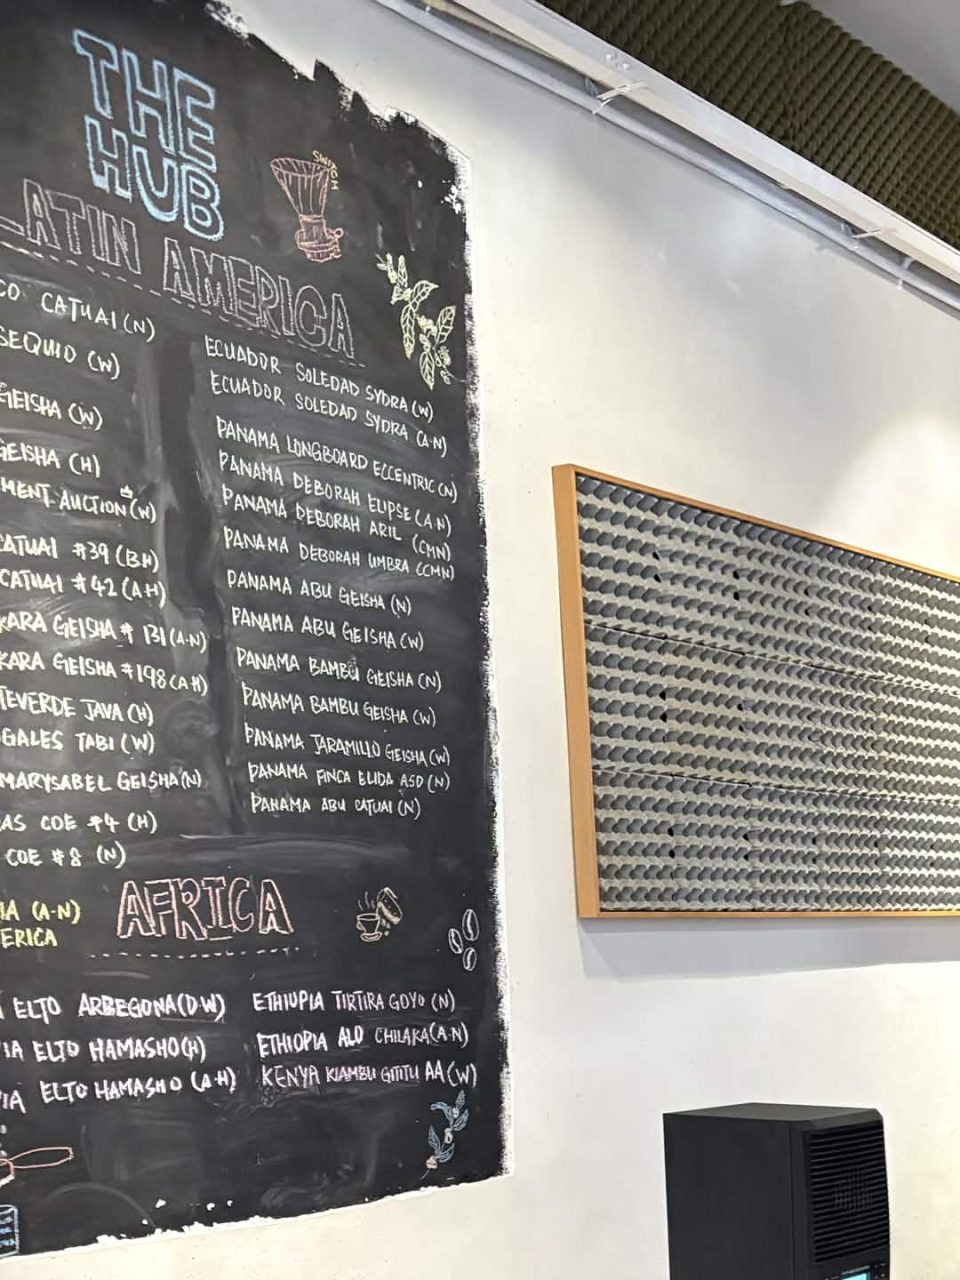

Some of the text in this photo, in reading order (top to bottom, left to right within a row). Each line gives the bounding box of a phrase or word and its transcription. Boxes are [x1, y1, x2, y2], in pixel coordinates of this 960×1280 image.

[73, 29, 216, 173] THE
[85, 115, 224, 241] HUB
[312, 150, 340, 190] SWITCH
[163, 238, 355, 359] AMERICA
[41, 292, 117, 330] CATUAI
[124, 312, 155, 343] (N)
[88, 350, 120, 380] (W)
[204, 334, 434, 424] ECUADOR SOLEDAD SYDRA (W)
[68, 403, 103, 431] (W)
[210, 370, 286, 407] ECUADOR
[295, 392, 358, 421] SOLEDAD
[364, 410, 409, 441] SYDRA
[69, 453, 100, 478] (H)
[216, 415, 458, 504] PANAMA LONGBOARD ECCENTRIC (N)
[219, 448, 284, 486] PANAMA
[293, 471, 361, 506] DEBORAH
[367, 492, 412, 522] ELIPSE
[59, 490, 126, 517] AUCTION
[130, 499, 156, 523] (W)
[222, 483, 451, 562] PANAMA DEBORAH ARIL (CMN)
[223, 525, 455, 581] PANAMA DEBORAH UMBRA (CMN)
[227, 568, 412, 616] PANAMA ABU GEISHA (N)
[53, 615, 118, 642] GEISHA
[231, 605, 424, 652] PANAMA ABU GEISHA (W)
[53, 652, 118, 678] GEISHA
[236, 647, 300, 672] PANAMA
[366, 667, 414, 688] GEISHA
[417, 670, 442, 694] (N)
[80, 699, 124, 721] JAVA
[127, 701, 154, 727] (H)
[241, 681, 437, 728] PANAMA BAMBU GEISHA (W)
[75, 732, 114, 753] TABI
[121, 731, 155, 755] (W)
[244, 722, 450, 768] PANAMA JARAMILLO GEISHA (W)
[0, 771, 112, 793] MARYSABEL
[248, 761, 308, 784] PANAMA
[316, 768, 350, 787] FINCA
[358, 770, 394, 787] ELIDA
[427, 771, 450, 794] (N)
[41, 813, 77, 831] COE
[127, 810, 158, 834] (H)
[250, 791, 421, 820] PANAMA ABU CATUAI (N)
[5, 848, 43, 867] COE
[96, 841, 126, 869] (N)
[117, 876, 294, 941] AFRICA
[0, 927, 57, 949] ERICA
[13, 995, 61, 1025] ELTO
[431, 988, 456, 1014] (N)
[32, 1040, 80, 1062] ELTO
[256, 1031, 328, 1058] ETHIOPIA
[40, 1080, 88, 1104] ELTO
[94, 1076, 182, 1101] HAMASHO
[262, 1064, 320, 1089] KENYA
[425, 1059, 445, 1085] AA
[447, 1060, 478, 1088] (W)
